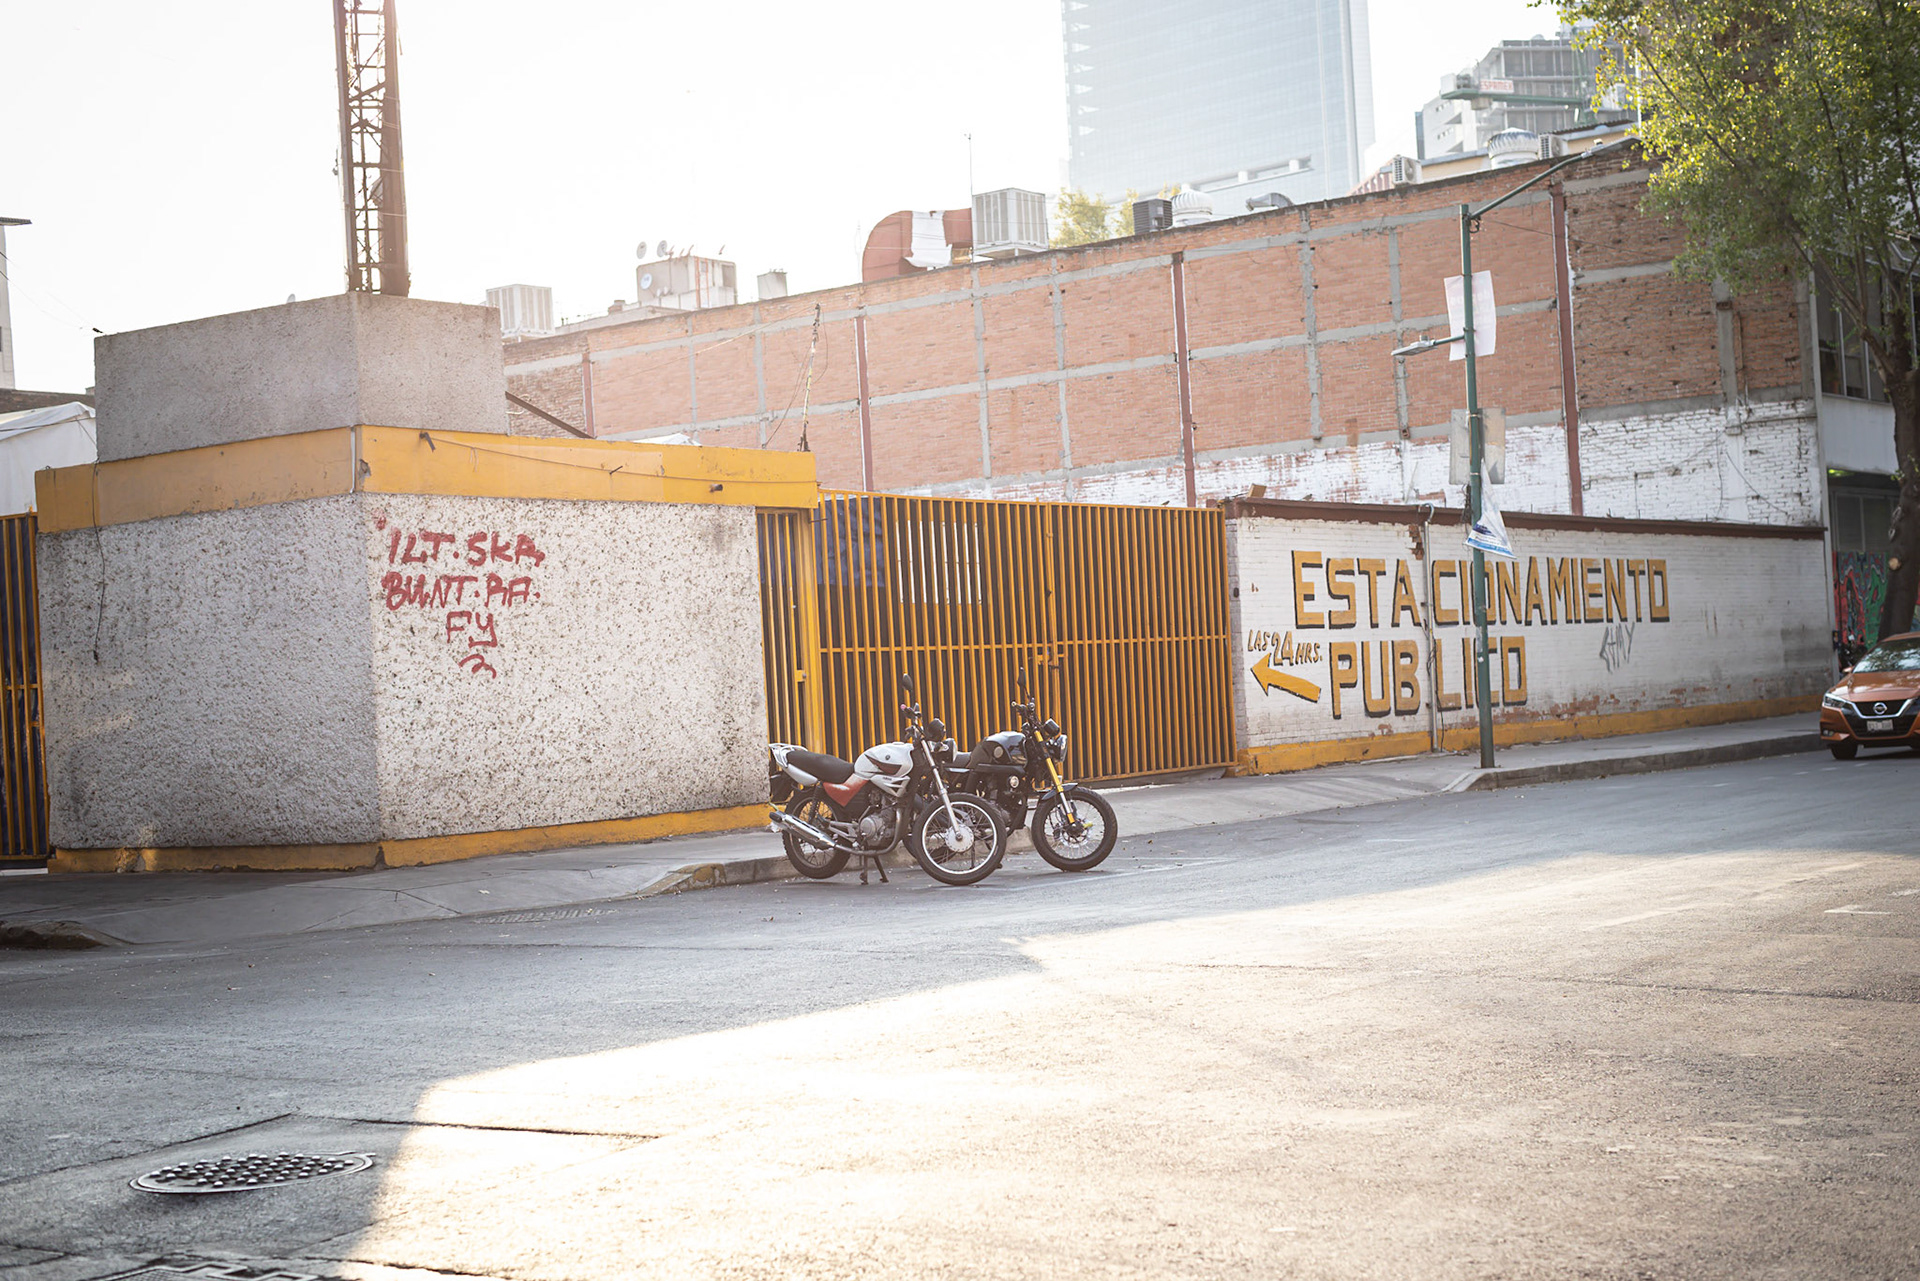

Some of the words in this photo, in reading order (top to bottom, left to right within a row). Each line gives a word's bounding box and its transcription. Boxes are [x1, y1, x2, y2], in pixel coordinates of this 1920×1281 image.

[1291, 550, 1670, 629] ESTACIONAMIENTO
[1247, 629, 1271, 652] LAS
[1271, 631, 1294, 667] 24
